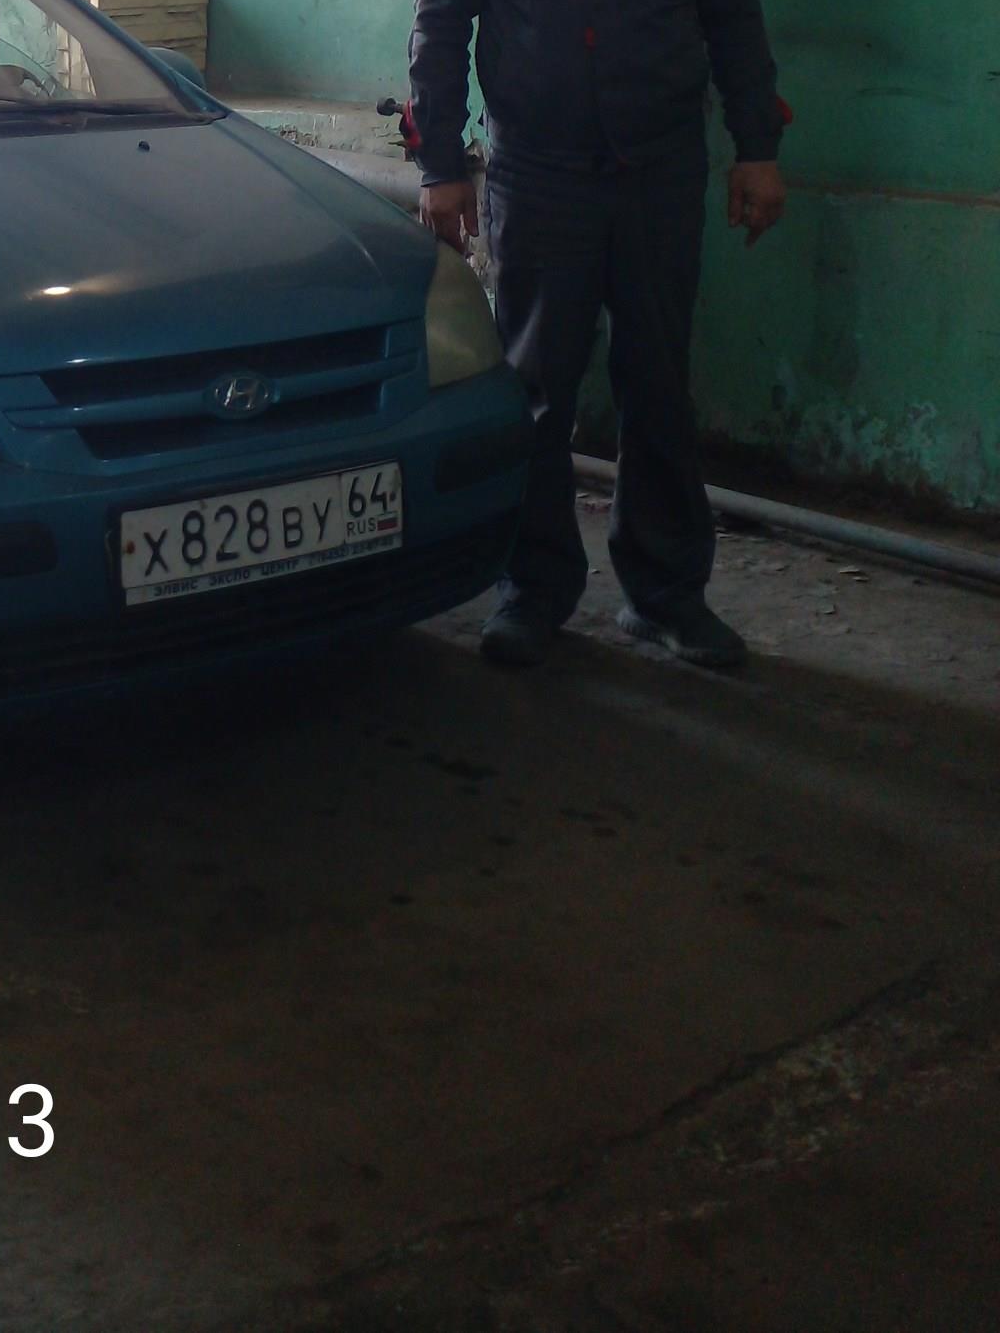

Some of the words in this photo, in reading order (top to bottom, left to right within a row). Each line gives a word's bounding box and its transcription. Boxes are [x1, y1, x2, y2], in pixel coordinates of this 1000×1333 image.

[144, 498, 333, 577] Х828ВУ
[347, 472, 388, 518] 64
[346, 517, 377, 537] RUS
